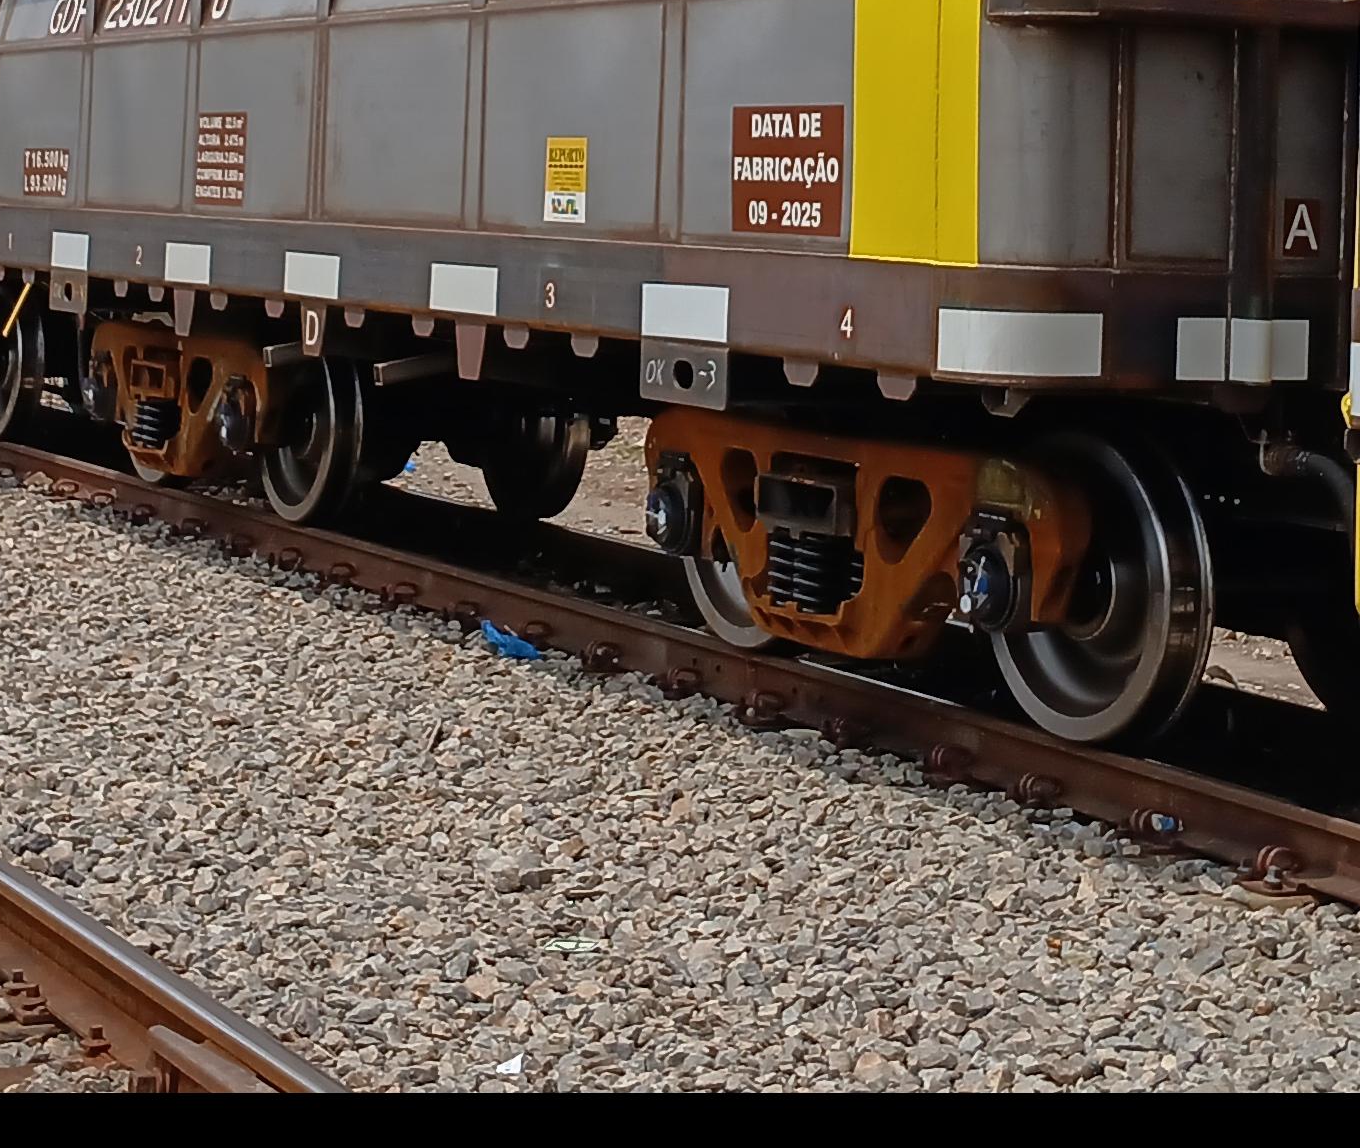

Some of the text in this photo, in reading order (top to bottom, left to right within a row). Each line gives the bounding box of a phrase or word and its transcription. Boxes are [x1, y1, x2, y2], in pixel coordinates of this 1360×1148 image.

[751, 112, 821, 138] DATA DE
[733, 152, 839, 189] FABRICAÇÃO
[748, 200, 768, 225] 09
[781, 201, 821, 228] 2025
[1284, 203, 1318, 250] A
[545, 282, 556, 309] 3
[305, 310, 319, 345] D
[840, 308, 853, 339] 4
[646, 359, 666, 386] OK
